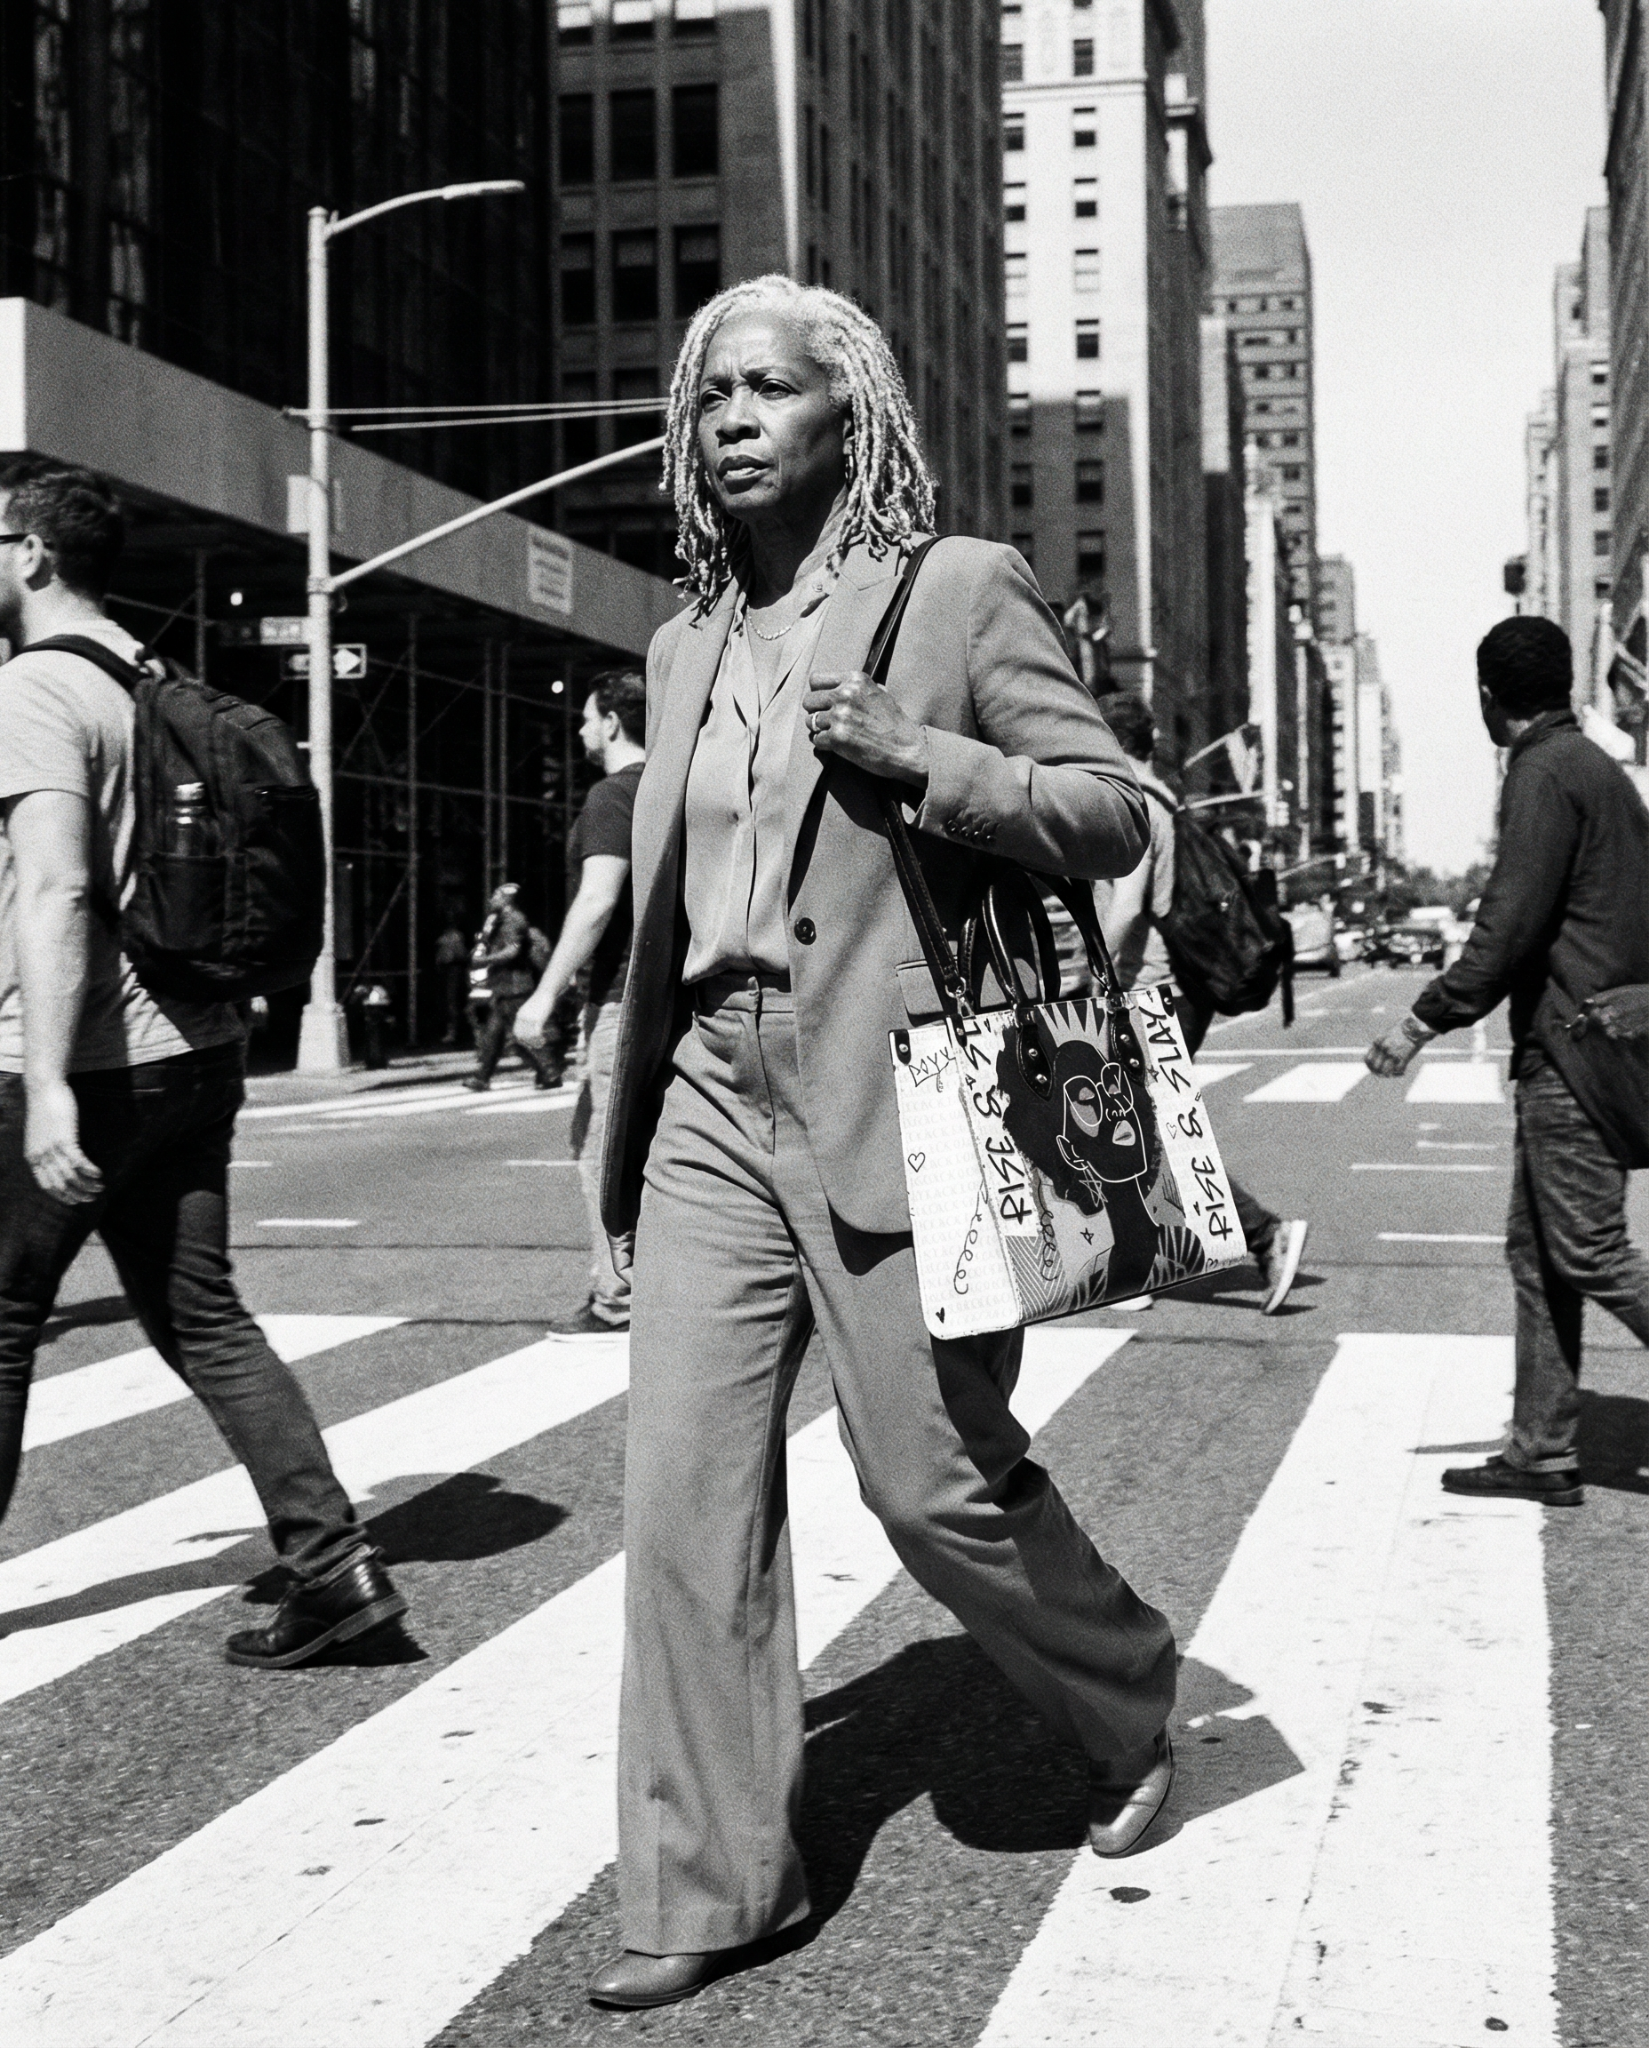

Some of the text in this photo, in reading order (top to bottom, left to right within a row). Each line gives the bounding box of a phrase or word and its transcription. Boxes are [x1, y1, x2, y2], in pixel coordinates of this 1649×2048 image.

[1138, 1005, 1192, 1094] SLAY
[972, 1084, 1003, 1119] &
[1177, 1107, 1203, 1140] &
[985, 1135, 1033, 1225] RISE
[1191, 1154, 1234, 1241] RISE
